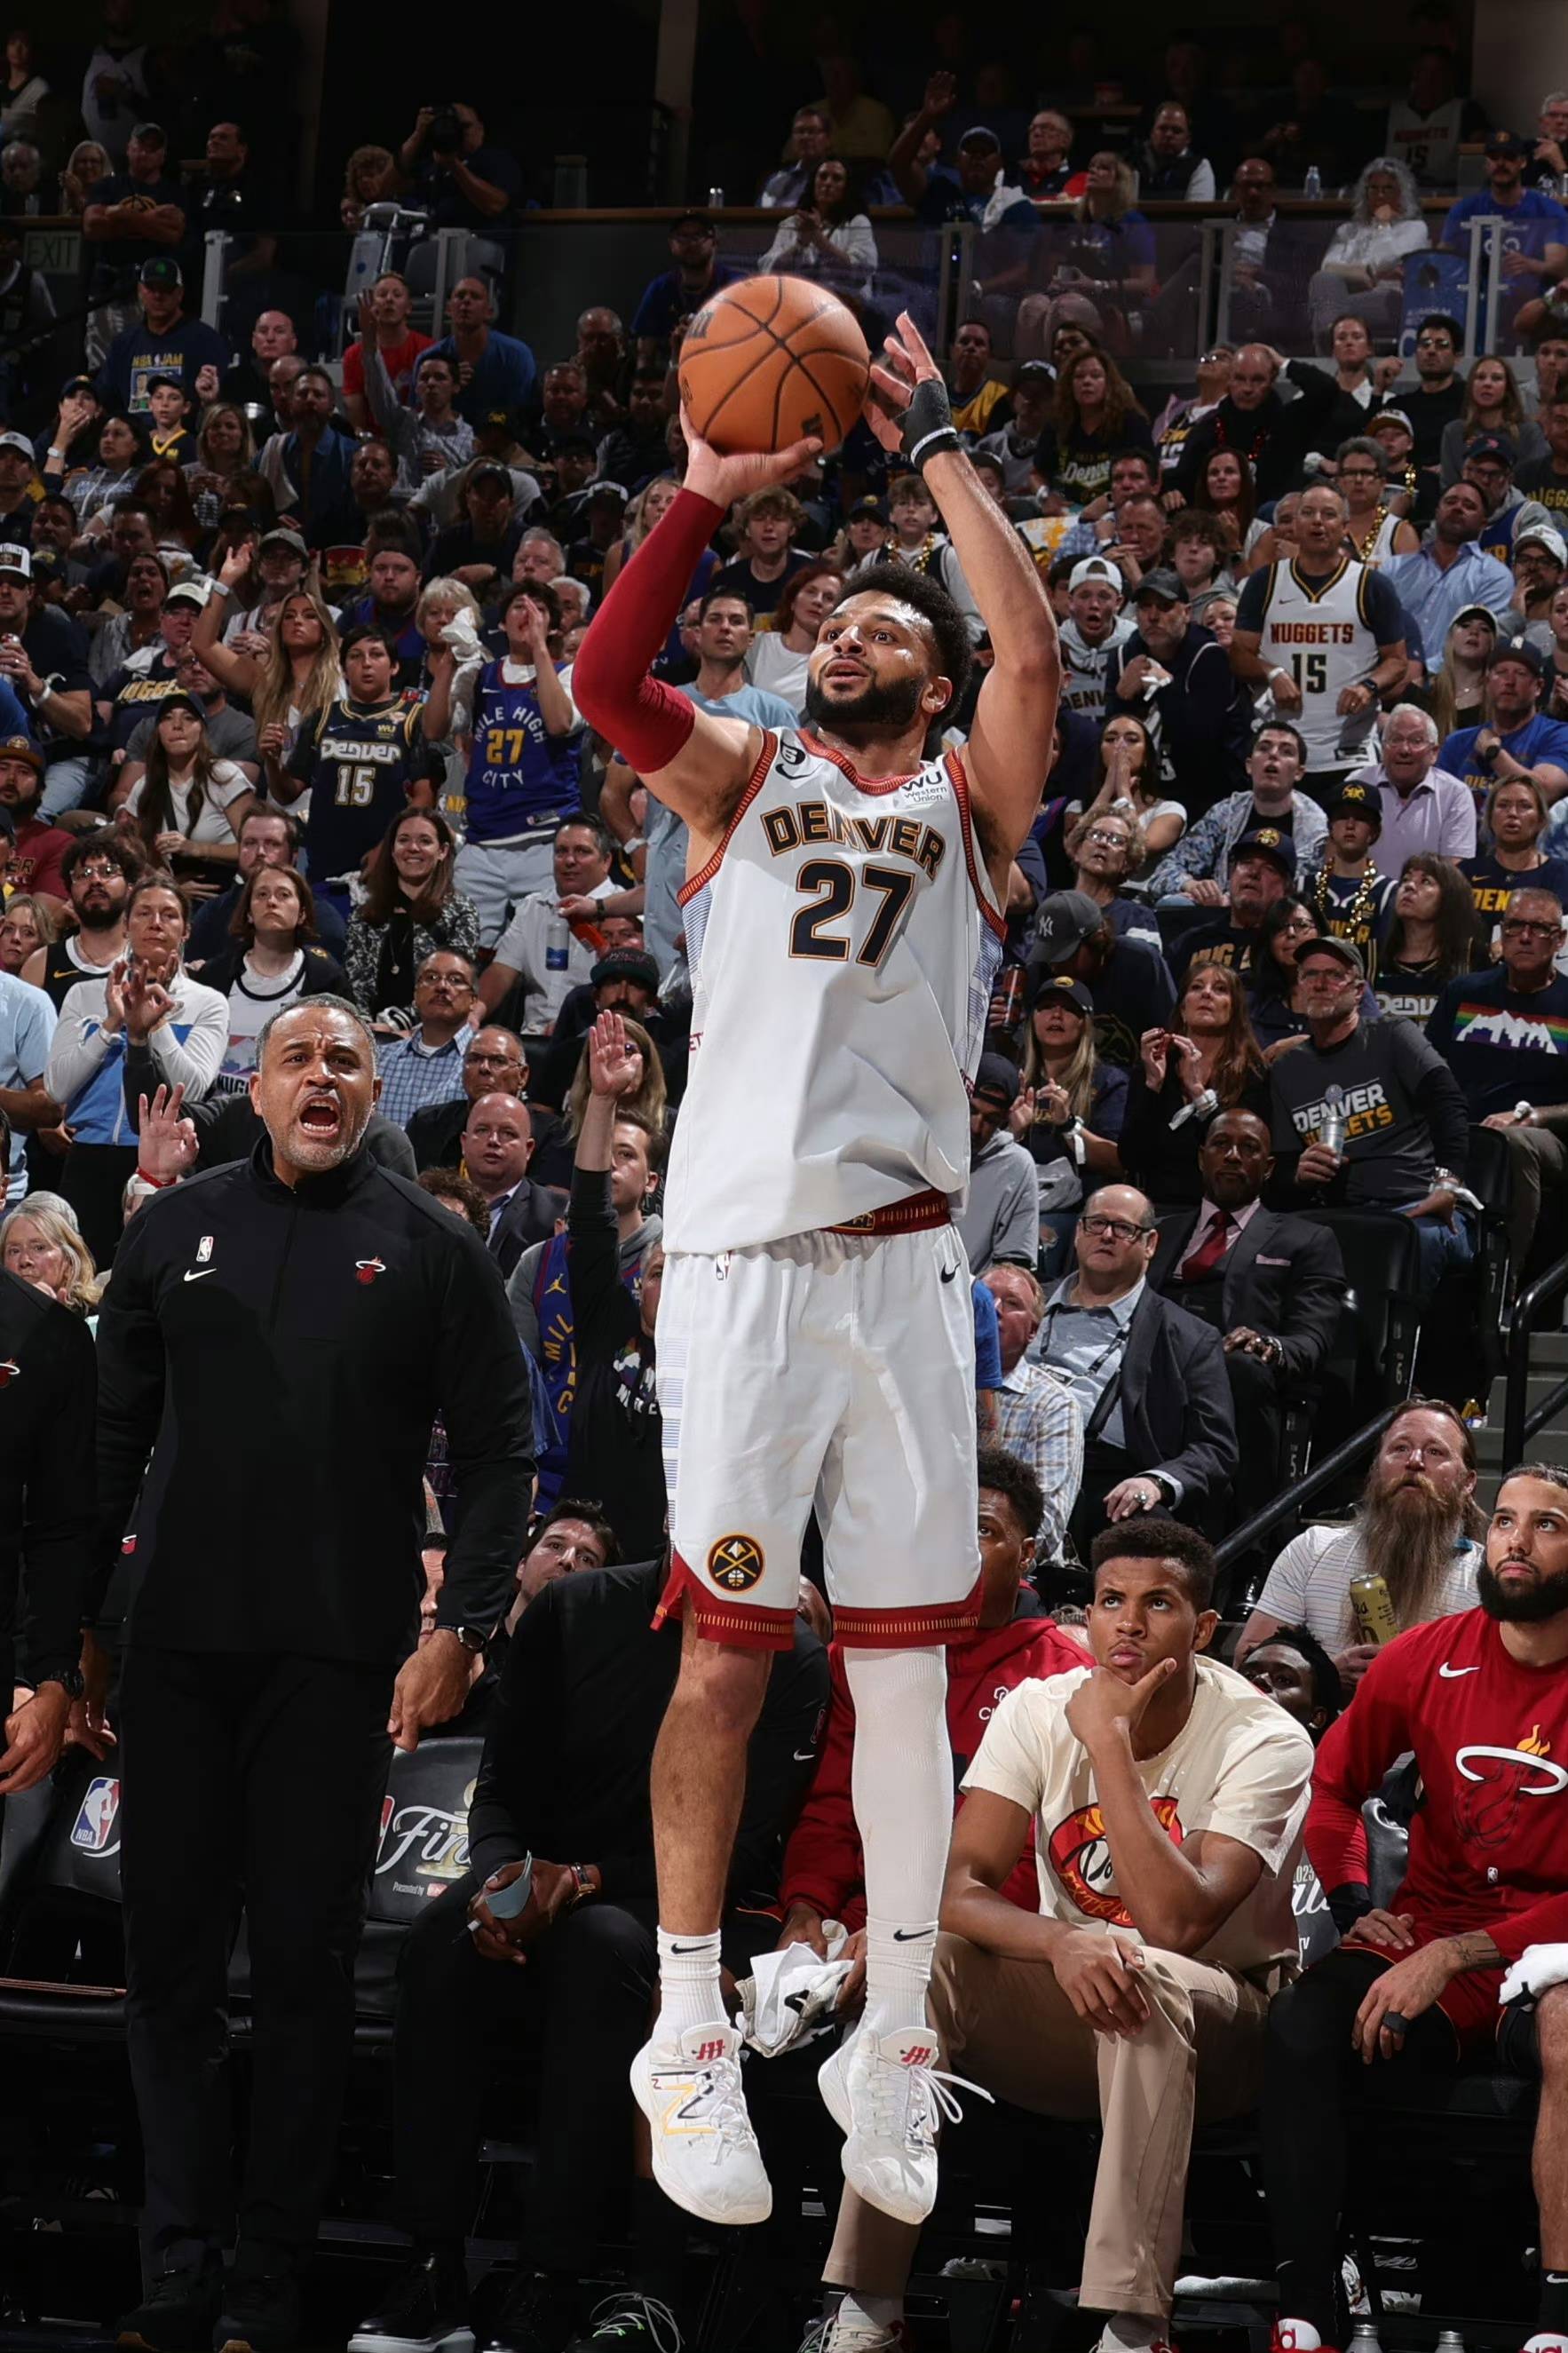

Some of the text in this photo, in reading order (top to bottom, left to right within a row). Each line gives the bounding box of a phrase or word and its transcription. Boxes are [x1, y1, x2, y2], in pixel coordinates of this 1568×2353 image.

[28, 235, 78, 268] EXIT
[1271, 622, 1354, 646] NUGGETS
[1292, 653, 1326, 694] 15
[474, 706, 548, 743] MILE HIGH
[486, 728, 526, 765] 27
[335, 765, 376, 807] 15
[482, 769, 525, 789] CITY
[902, 771, 942, 792] WU
[904, 786, 946, 799] Western
[913, 793, 943, 803] Union
[760, 801, 946, 880] DENVER
[788, 859, 915, 967] 27
[1038, 915, 1055, 938] NY
[1293, 1082, 1387, 1133] DENVER
[75, 1828, 93, 1842] NBA
[375, 1805, 471, 1875] Fin
[1293, 1865, 1316, 1883] 023
